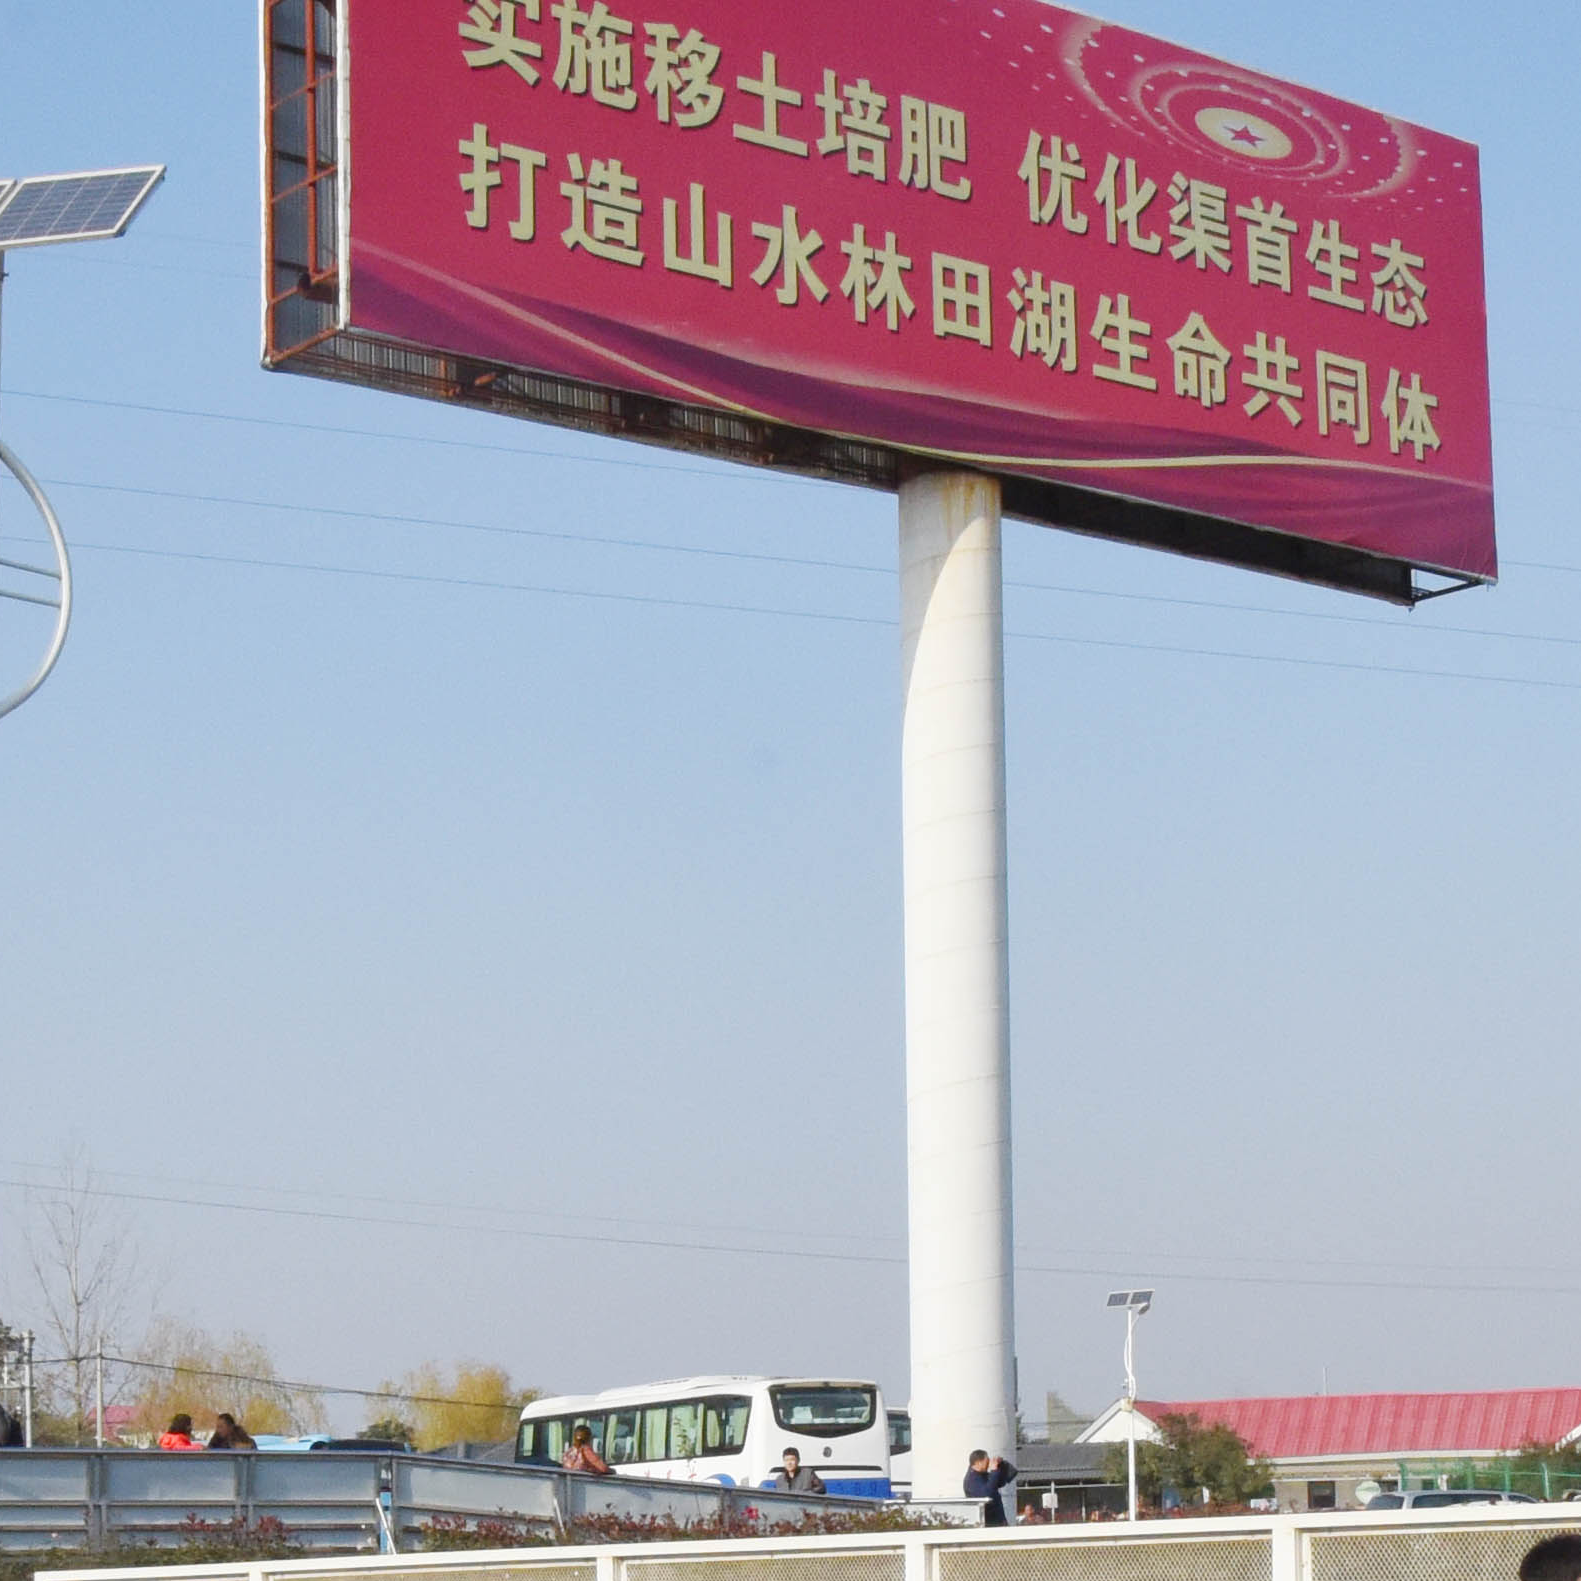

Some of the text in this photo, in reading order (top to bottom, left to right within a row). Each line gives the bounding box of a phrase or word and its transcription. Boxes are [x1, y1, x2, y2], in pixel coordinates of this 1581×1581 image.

[457, 0, 1429, 329] 实施移土培肥 优化渠首生态
[458, 122, 1442, 462] 打造山水林田湖生命共同体
